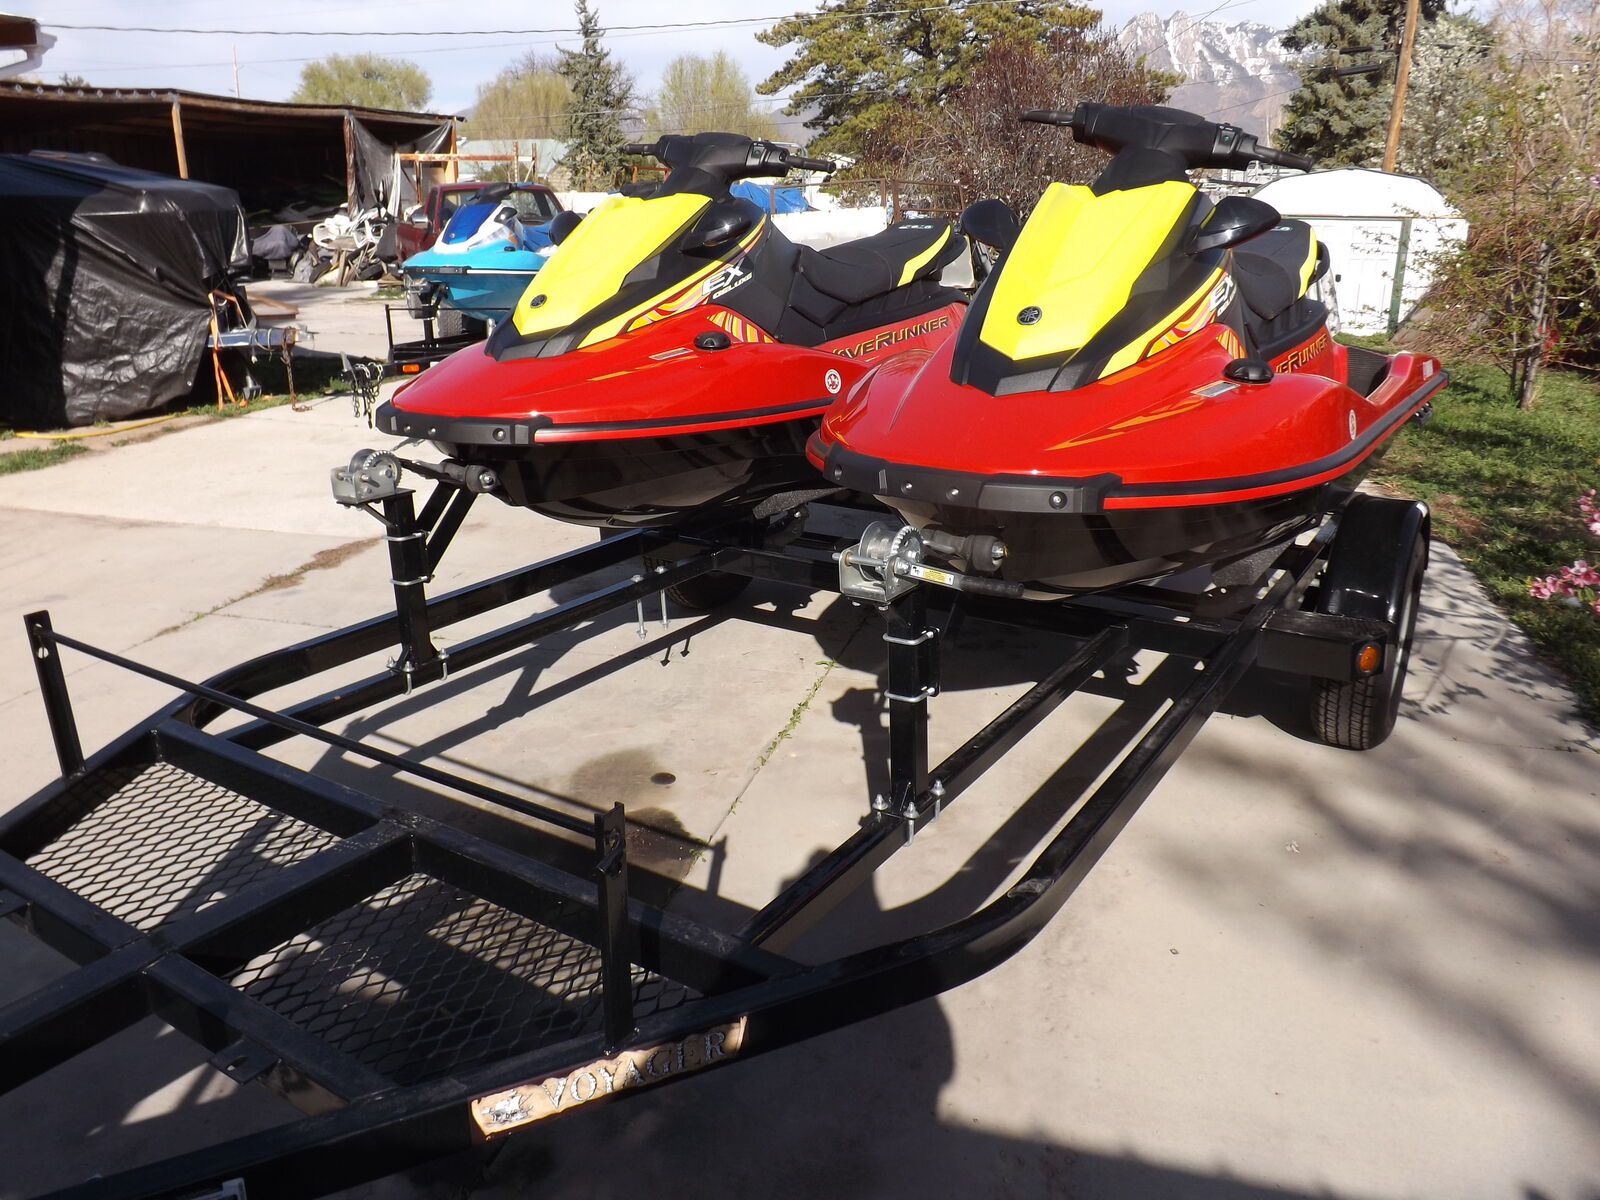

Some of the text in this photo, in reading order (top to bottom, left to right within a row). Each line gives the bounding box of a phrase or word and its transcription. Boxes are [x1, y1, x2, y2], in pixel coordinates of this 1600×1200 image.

[702, 258, 745, 296] EX
[1210, 275, 1233, 312] EX
[831, 315, 949, 358] AVERUNNER
[542, 1031, 726, 1109] VOYAGER
